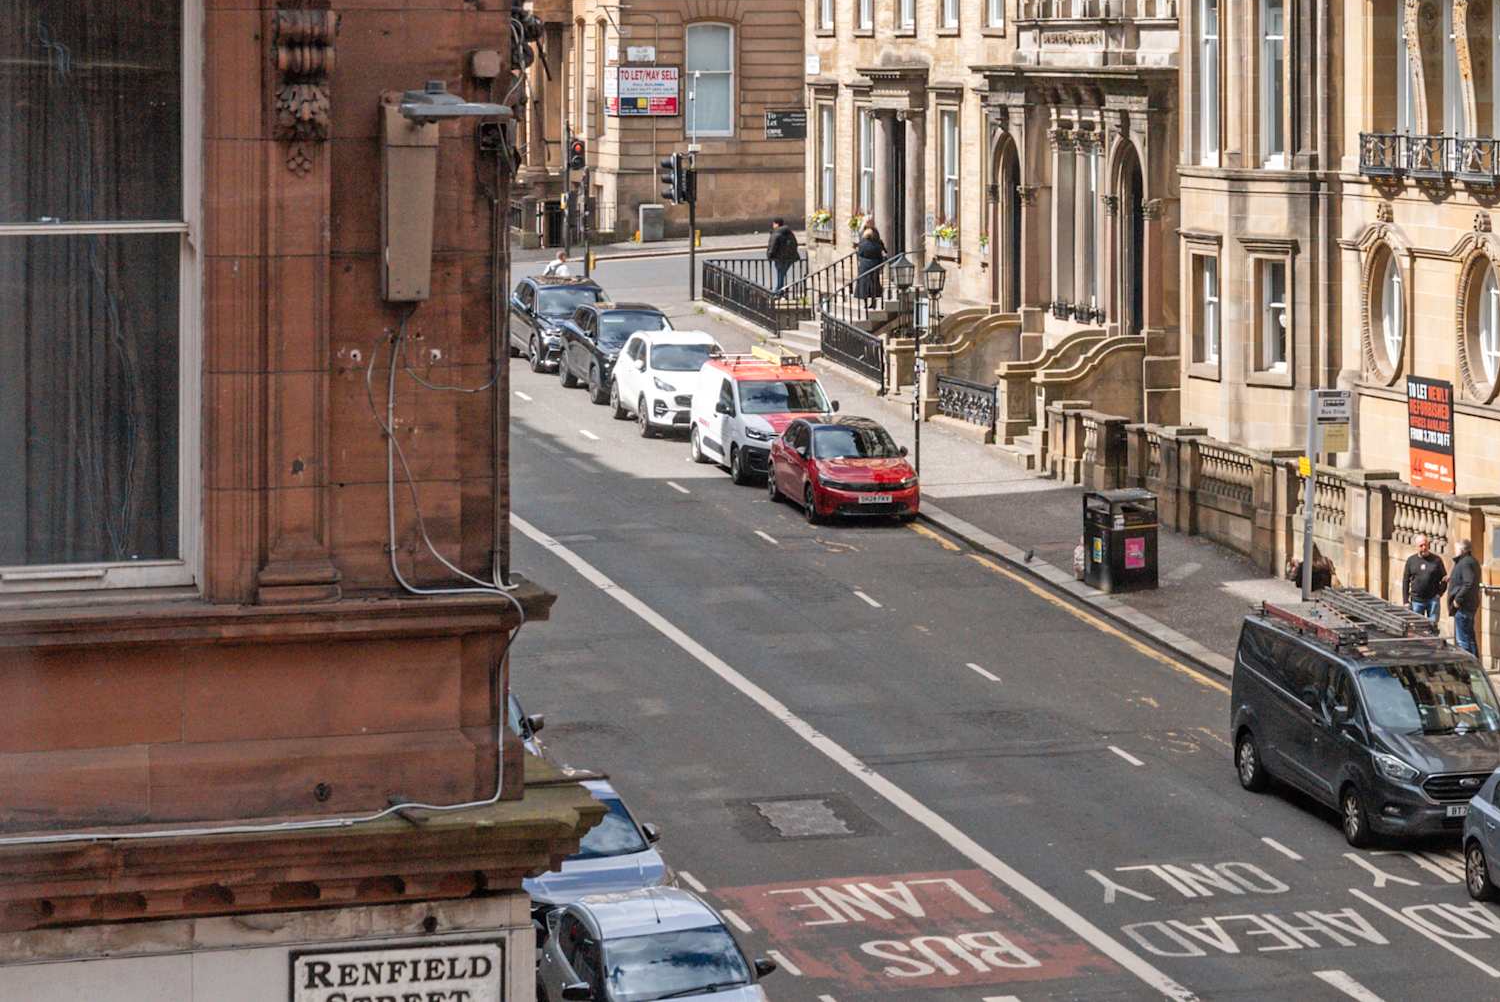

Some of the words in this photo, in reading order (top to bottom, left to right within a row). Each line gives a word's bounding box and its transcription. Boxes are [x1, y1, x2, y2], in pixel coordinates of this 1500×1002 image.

[661, 70, 678, 80] SELL
[1408, 382, 1416, 397] TO
[1416, 384, 1427, 400] LET
[767, 877, 994, 926] LANE
[1085, 861, 1290, 903] ONLY
[1120, 907, 1391, 957] AHEAD
[304, 955, 493, 989] RENFIELD
[860, 930, 1043, 978] BUS
